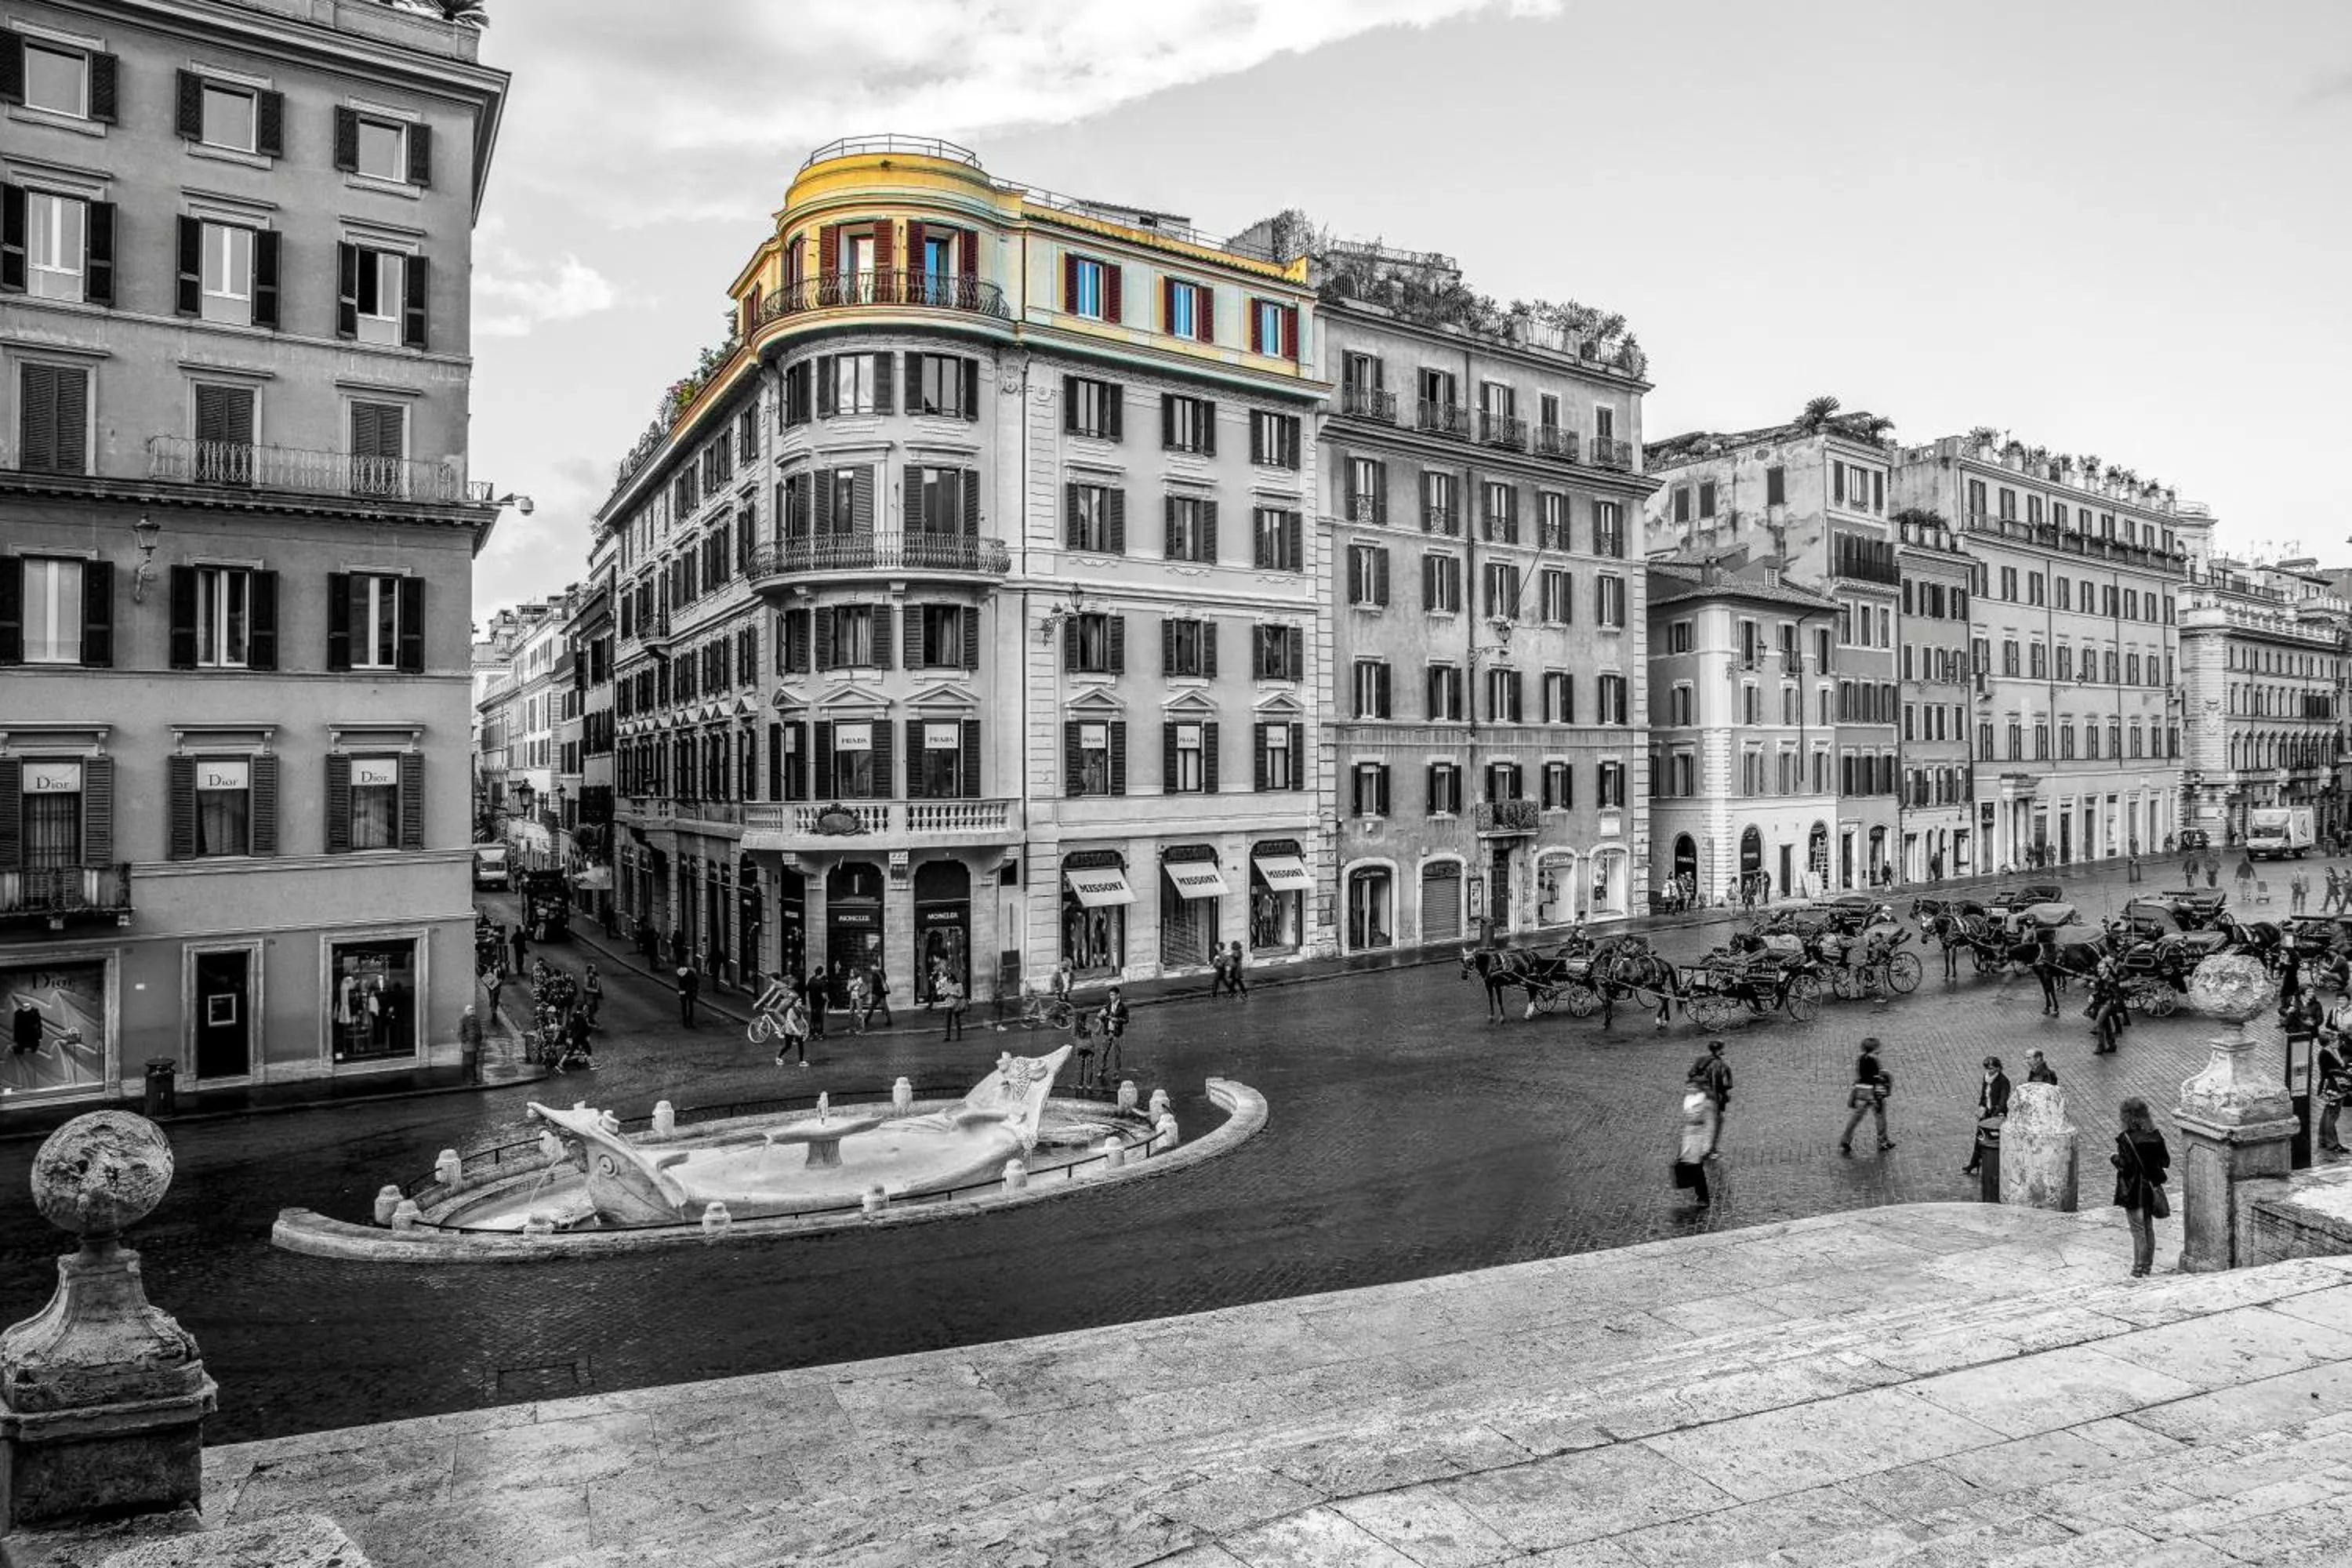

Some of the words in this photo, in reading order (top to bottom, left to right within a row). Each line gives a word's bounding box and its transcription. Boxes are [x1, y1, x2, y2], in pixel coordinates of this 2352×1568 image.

[209, 775, 238, 786] Dior
[361, 771, 388, 783] Dior
[37, 777, 70, 789] Dior
[1266, 868, 1305, 879] MISSONI
[1177, 874, 1218, 885] MISSONI
[1078, 881, 1124, 893] MISSONI
